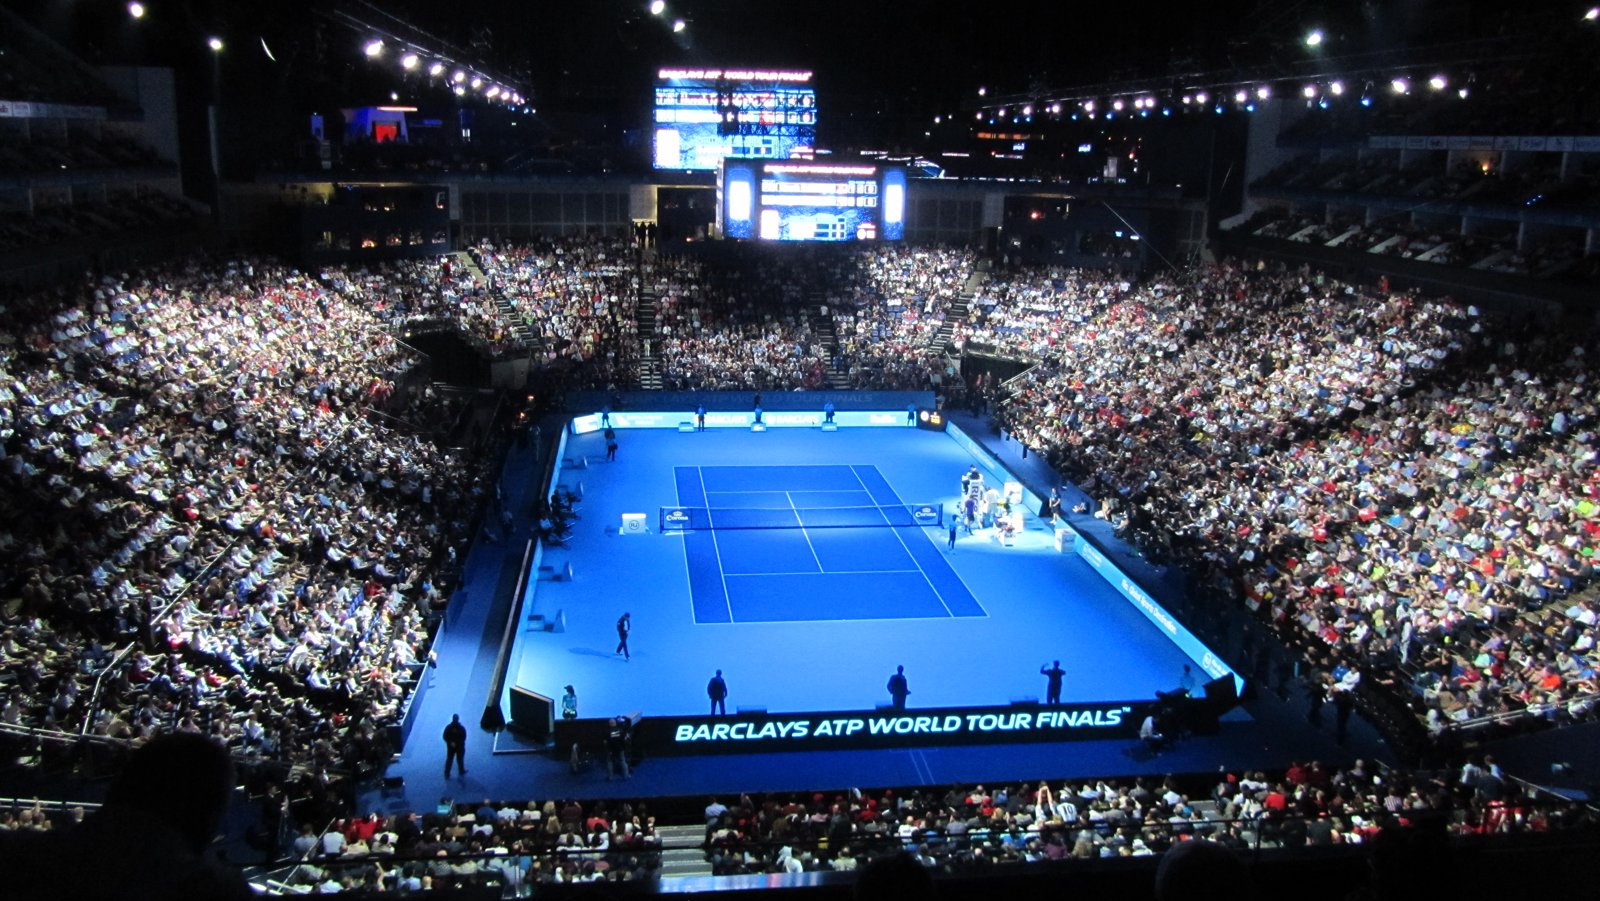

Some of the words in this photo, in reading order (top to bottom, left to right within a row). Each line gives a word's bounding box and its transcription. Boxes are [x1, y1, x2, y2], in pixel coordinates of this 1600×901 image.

[675, 720, 810, 741] BARCLAYS
[813, 719, 864, 736] ATP
[869, 715, 961, 735] WORLD
[966, 712, 1032, 732] TOUR
